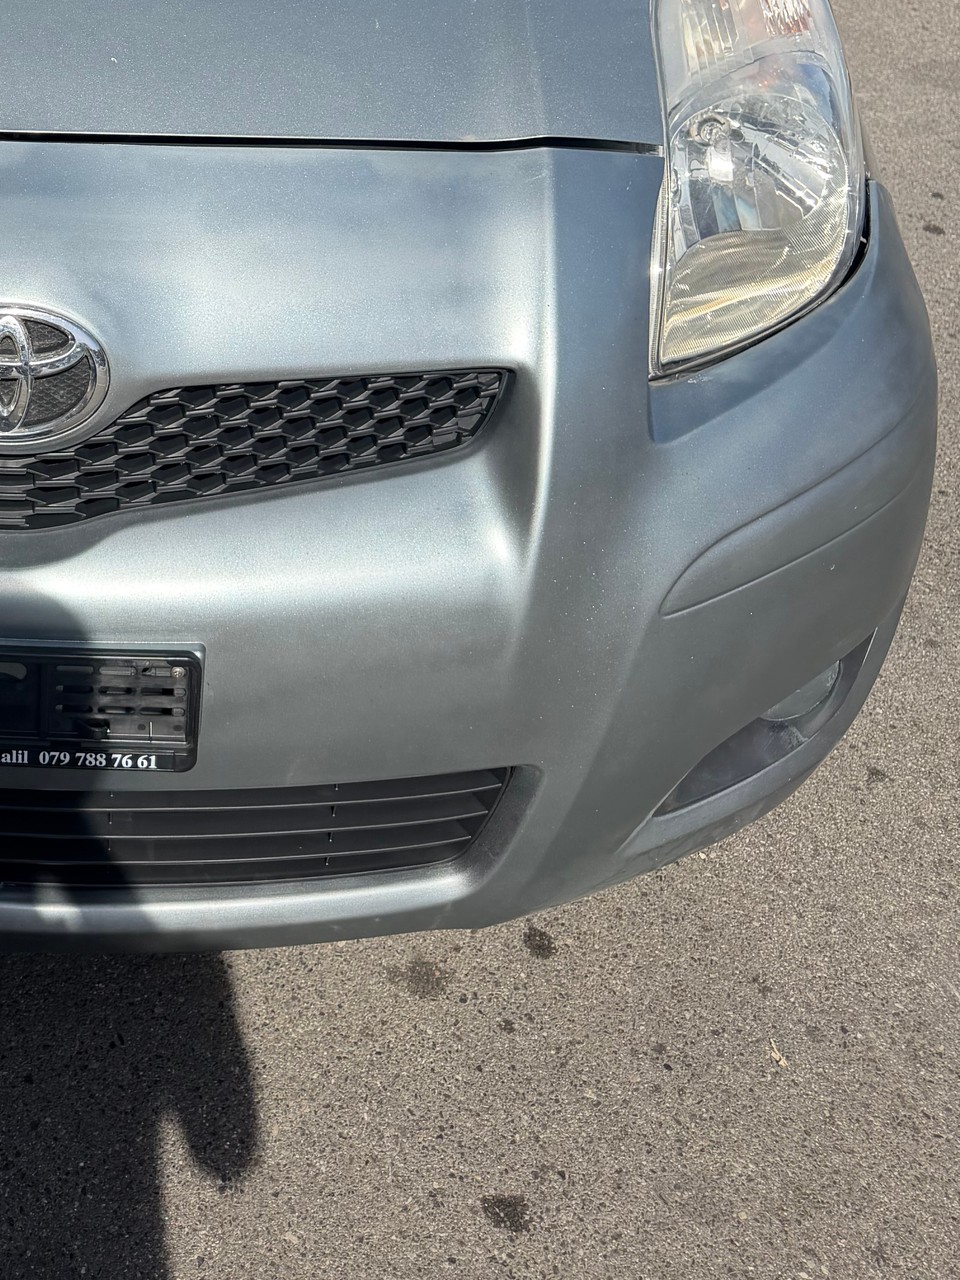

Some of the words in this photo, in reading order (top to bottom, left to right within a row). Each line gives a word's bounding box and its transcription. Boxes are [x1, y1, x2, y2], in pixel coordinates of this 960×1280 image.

[38, 751, 71, 766] 079
[75, 752, 107, 767] 788
[111, 754, 133, 768] 76
[136, 754, 158, 769] 61
